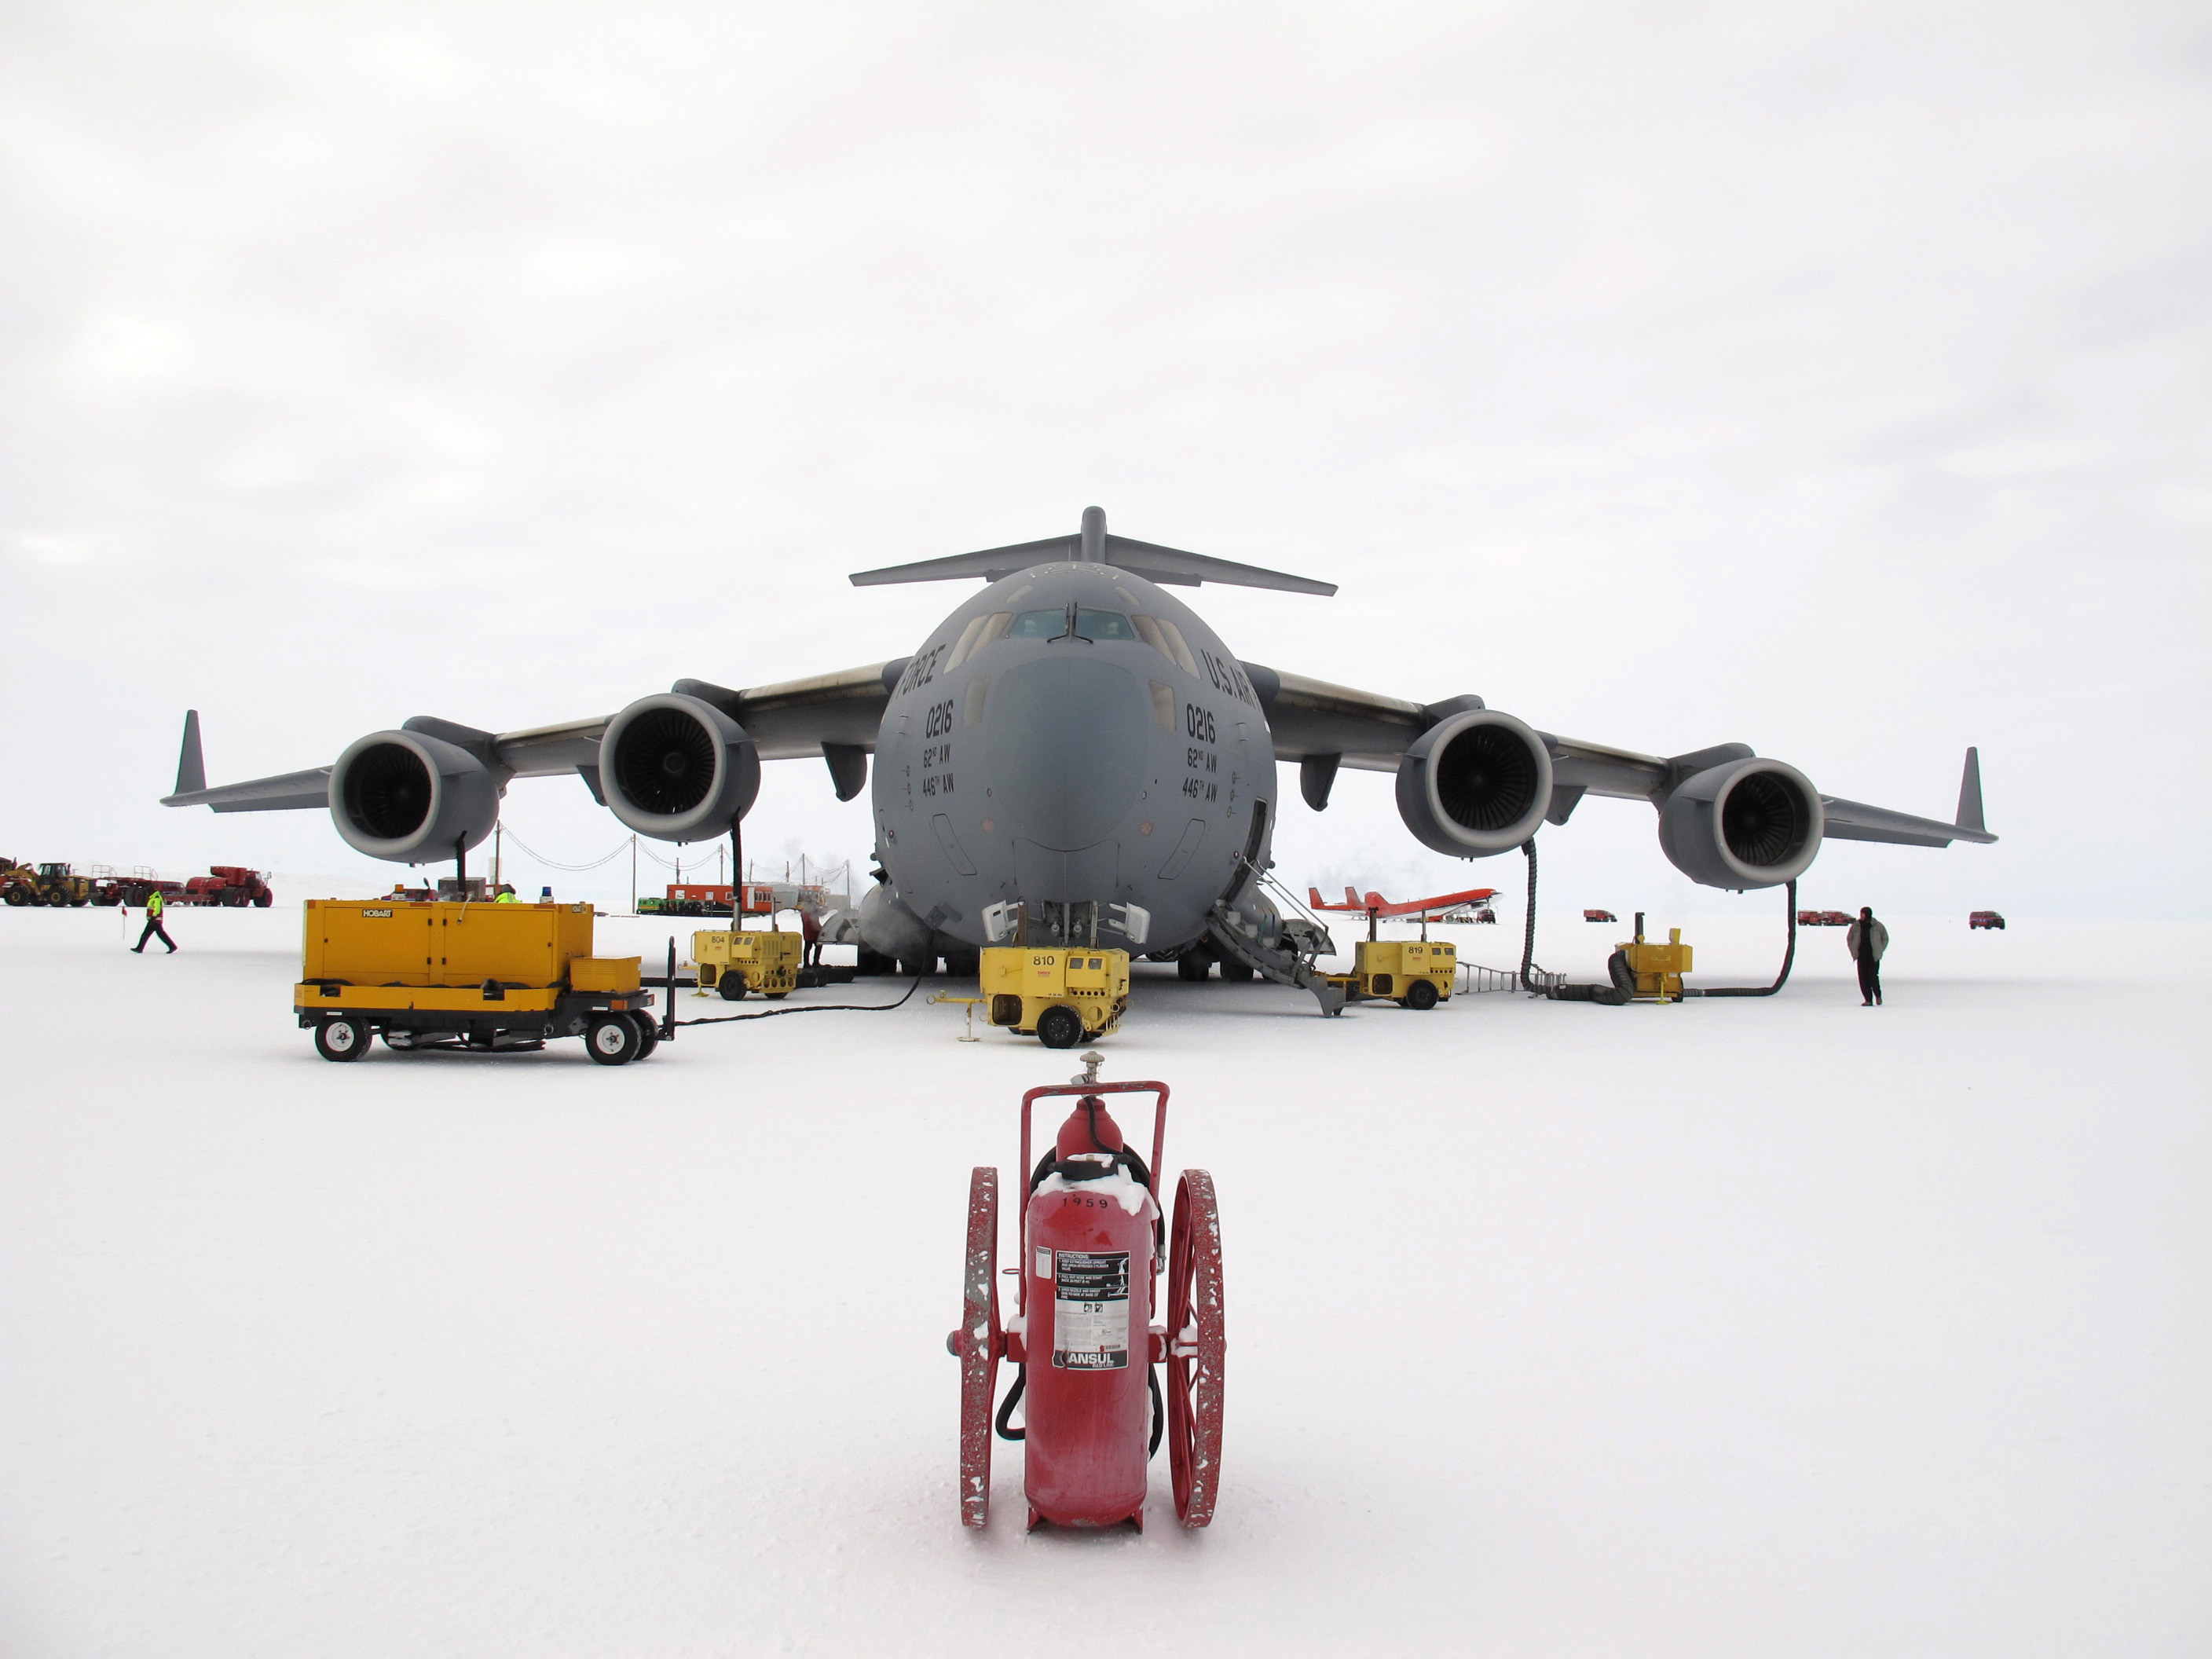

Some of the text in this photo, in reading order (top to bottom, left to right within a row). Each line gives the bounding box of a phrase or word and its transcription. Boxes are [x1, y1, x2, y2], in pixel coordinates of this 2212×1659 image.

[925, 698, 953, 739] 0216
[1186, 703, 1216, 744] 0216
[939, 743, 950, 765] AW
[1206, 753, 1217, 774] AW
[943, 772, 954, 794] AW
[1205, 782, 1218, 803] AW
[1033, 955, 1054, 965] 810
[1063, 1197, 1108, 1208] 1959
[1068, 1353, 1115, 1364] ANSUL
